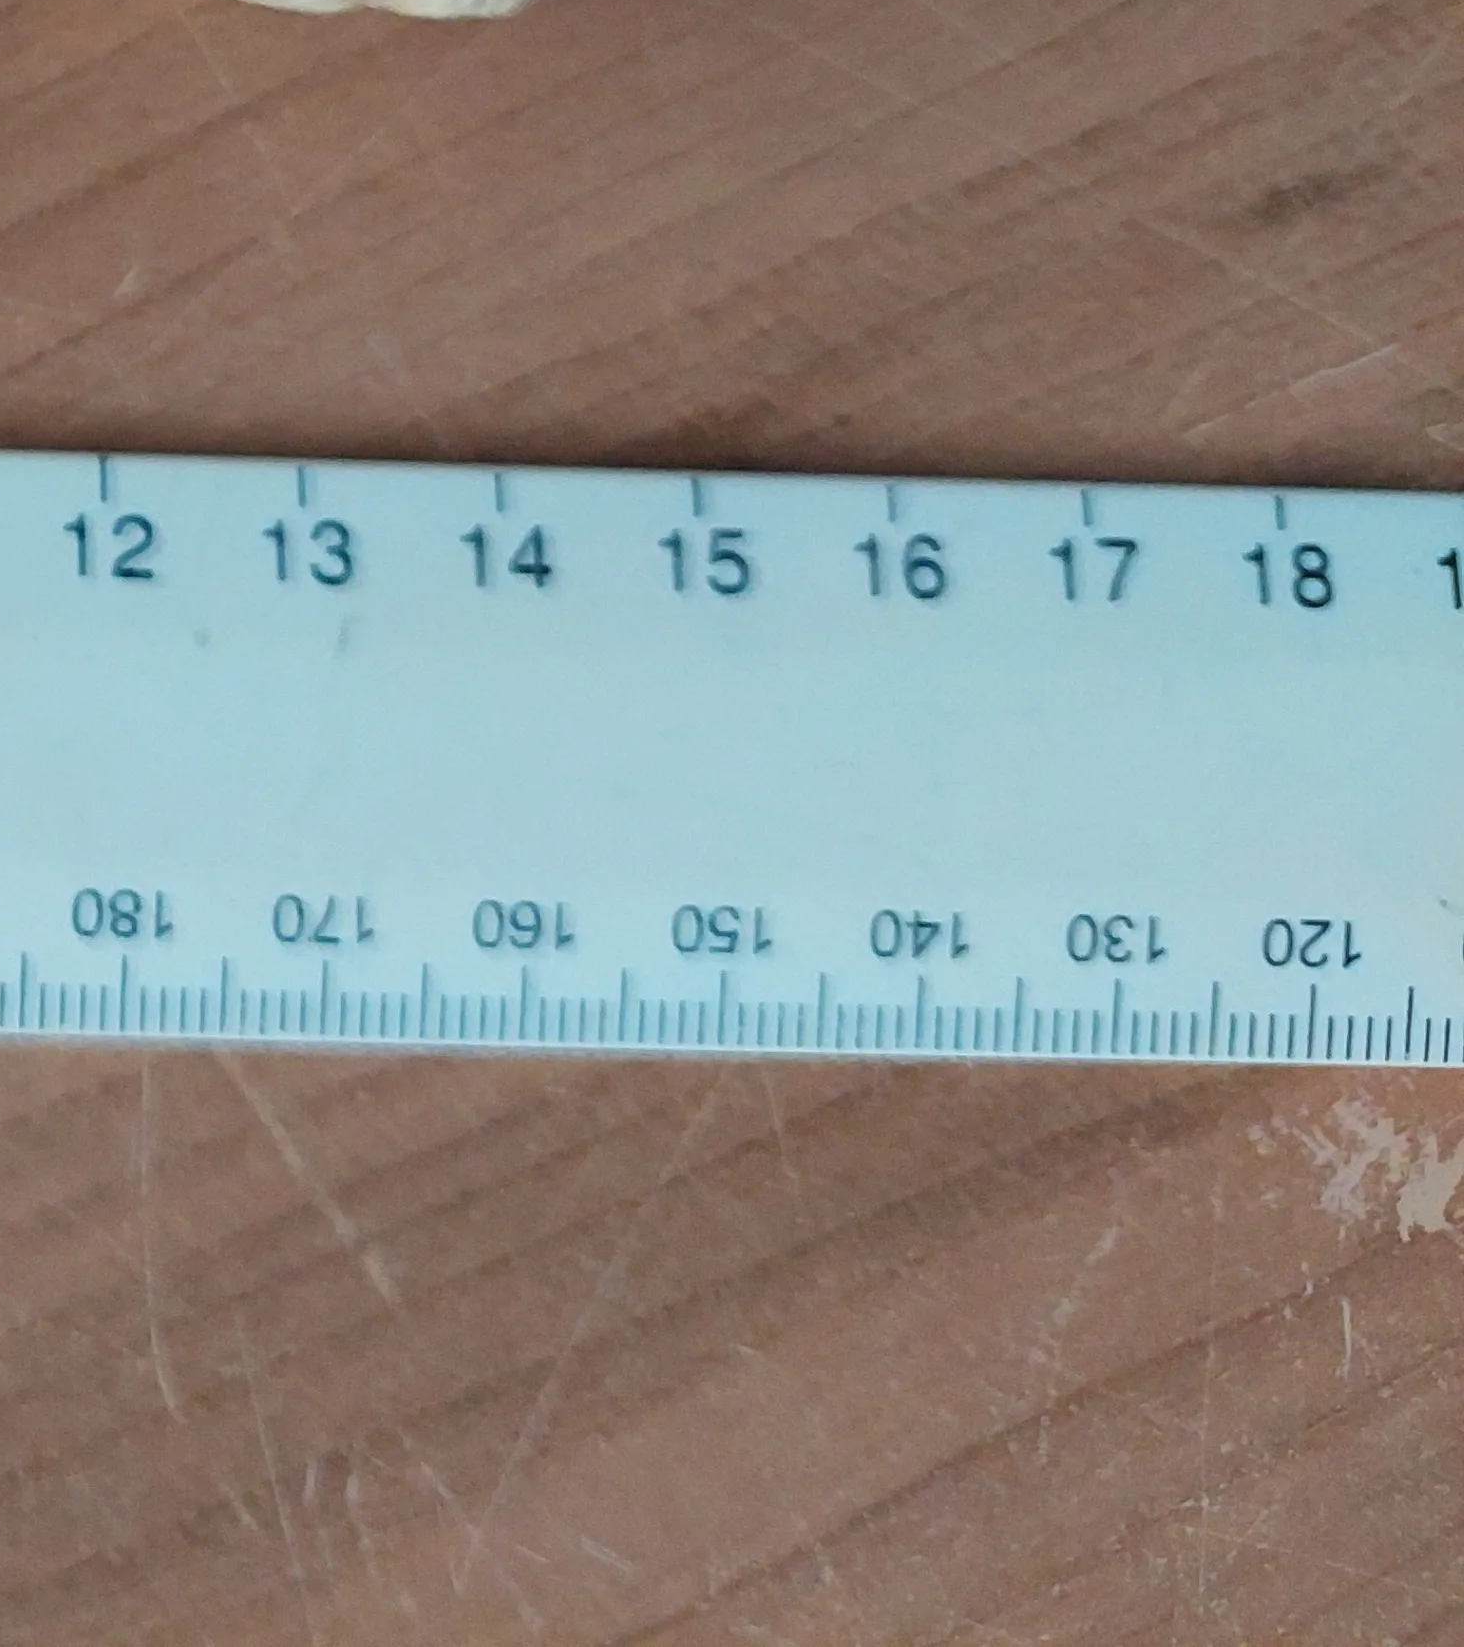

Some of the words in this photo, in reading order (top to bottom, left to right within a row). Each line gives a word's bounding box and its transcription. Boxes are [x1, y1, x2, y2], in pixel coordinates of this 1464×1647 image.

[63, 513, 156, 581] 12
[263, 520, 356, 587] 13
[461, 525, 554, 589] 14
[659, 529, 752, 598] 15
[854, 534, 949, 602] 16
[1050, 537, 1139, 603] 17
[1243, 543, 1336, 609] 18
[1437, 548, 1464, 610] 1
[72, 889, 174, 939] 180
[273, 895, 375, 945] 170
[473, 900, 575, 950] 160
[672, 905, 773, 955] 150
[871, 909, 970, 959] 140
[1067, 914, 1167, 963] 130
[1262, 919, 1362, 969] 120
